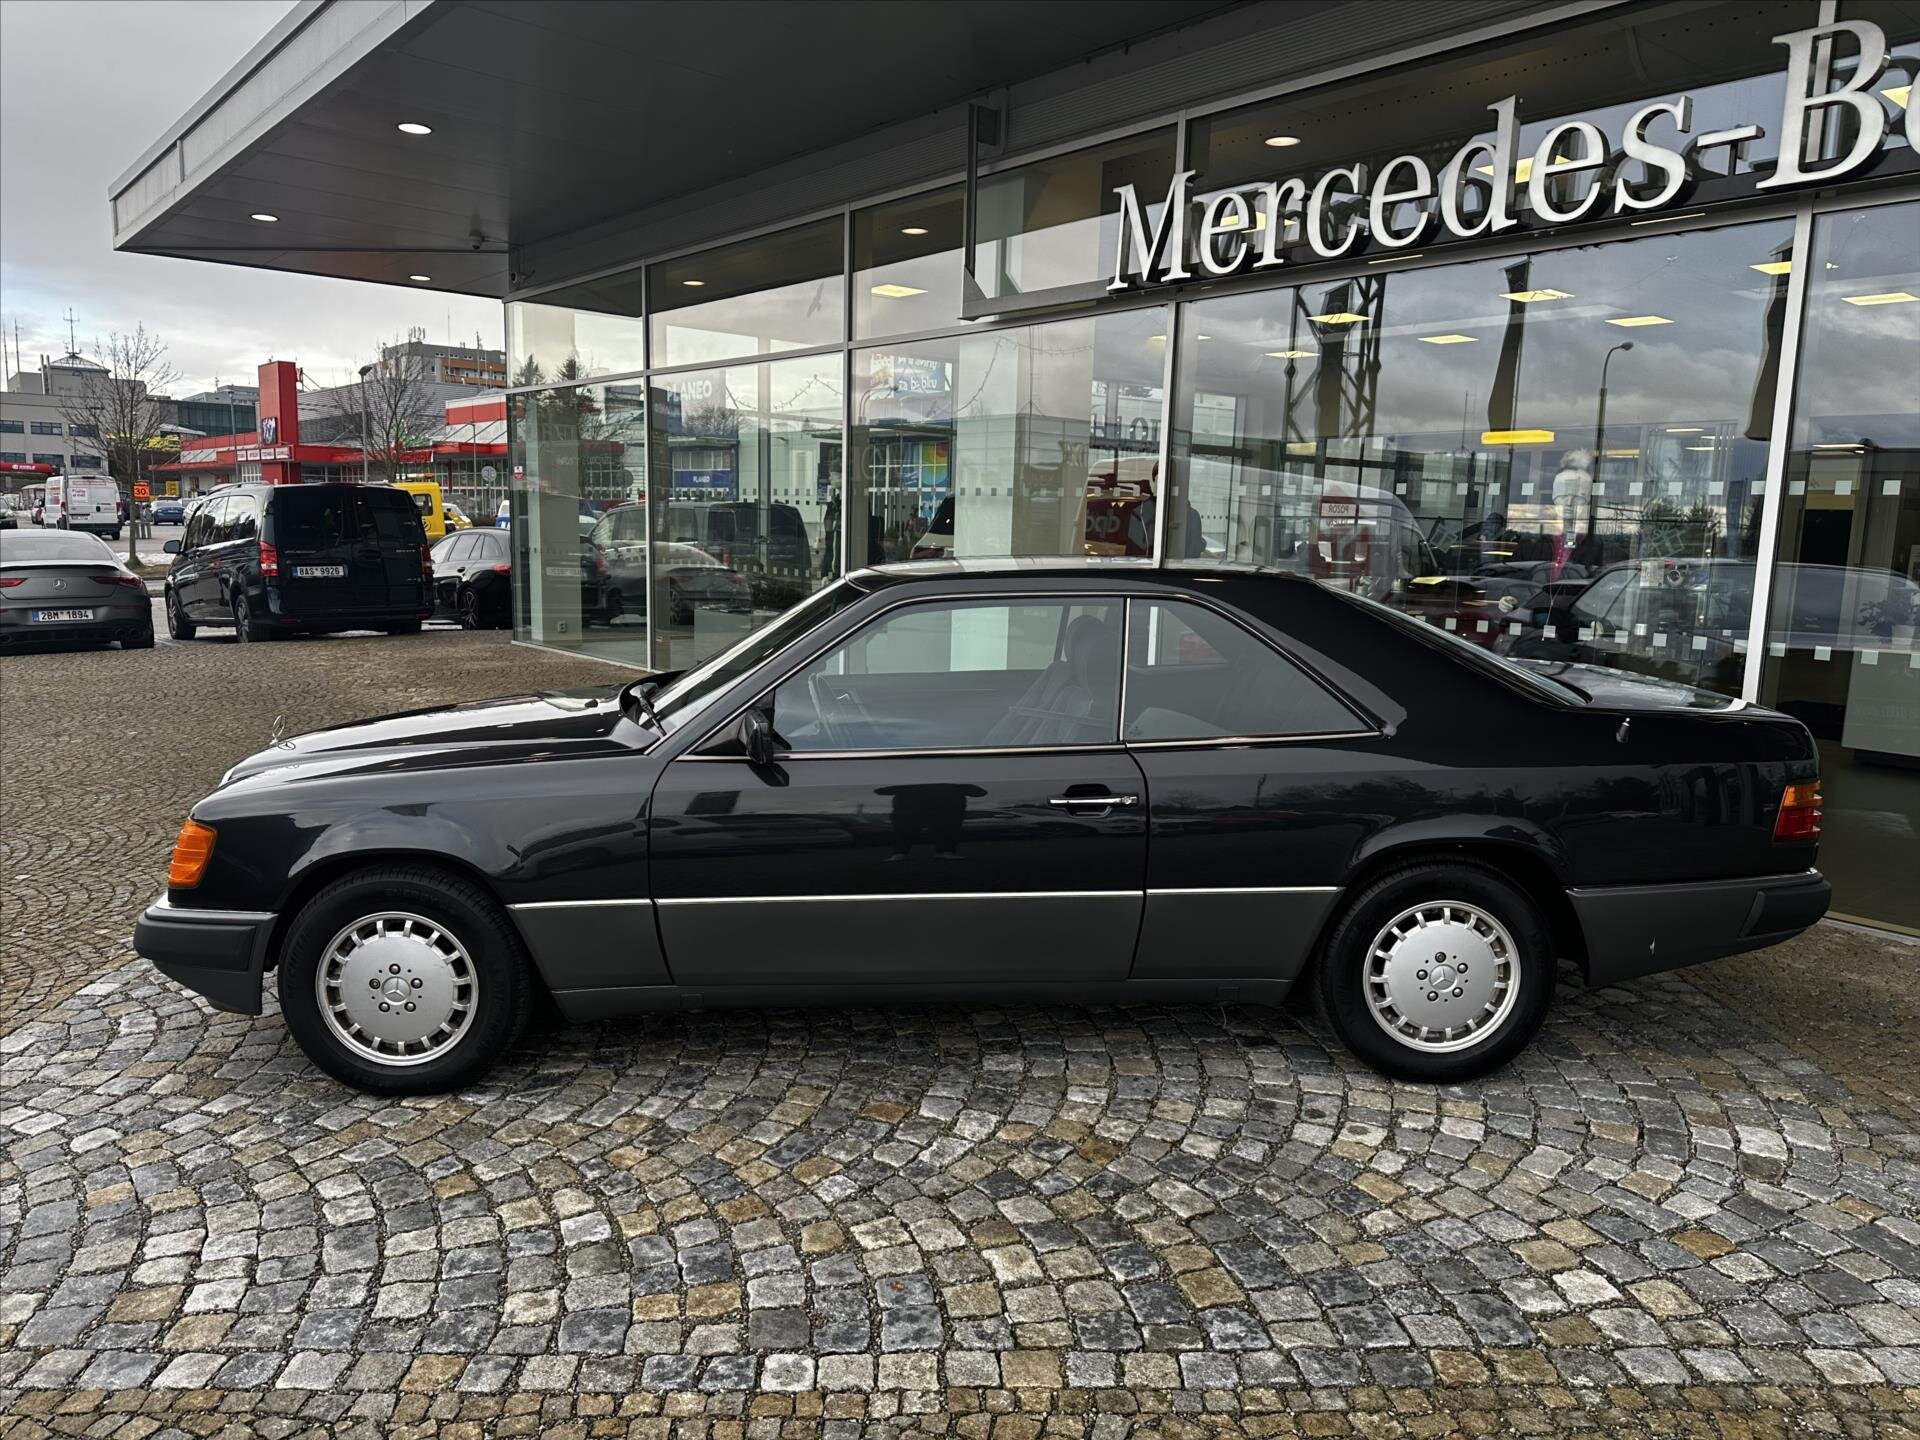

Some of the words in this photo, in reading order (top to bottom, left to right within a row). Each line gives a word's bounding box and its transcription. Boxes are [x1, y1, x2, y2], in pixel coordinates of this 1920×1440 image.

[1107, 20, 1920, 290] Mercedes-B
[666, 380, 712, 402] PLANEO
[134, 487, 146, 496] 30
[299, 567, 315, 576] 8AS
[320, 566, 340, 576] 9926
[41, 611, 60, 621] 2BM
[66, 610, 89, 619] 1894
